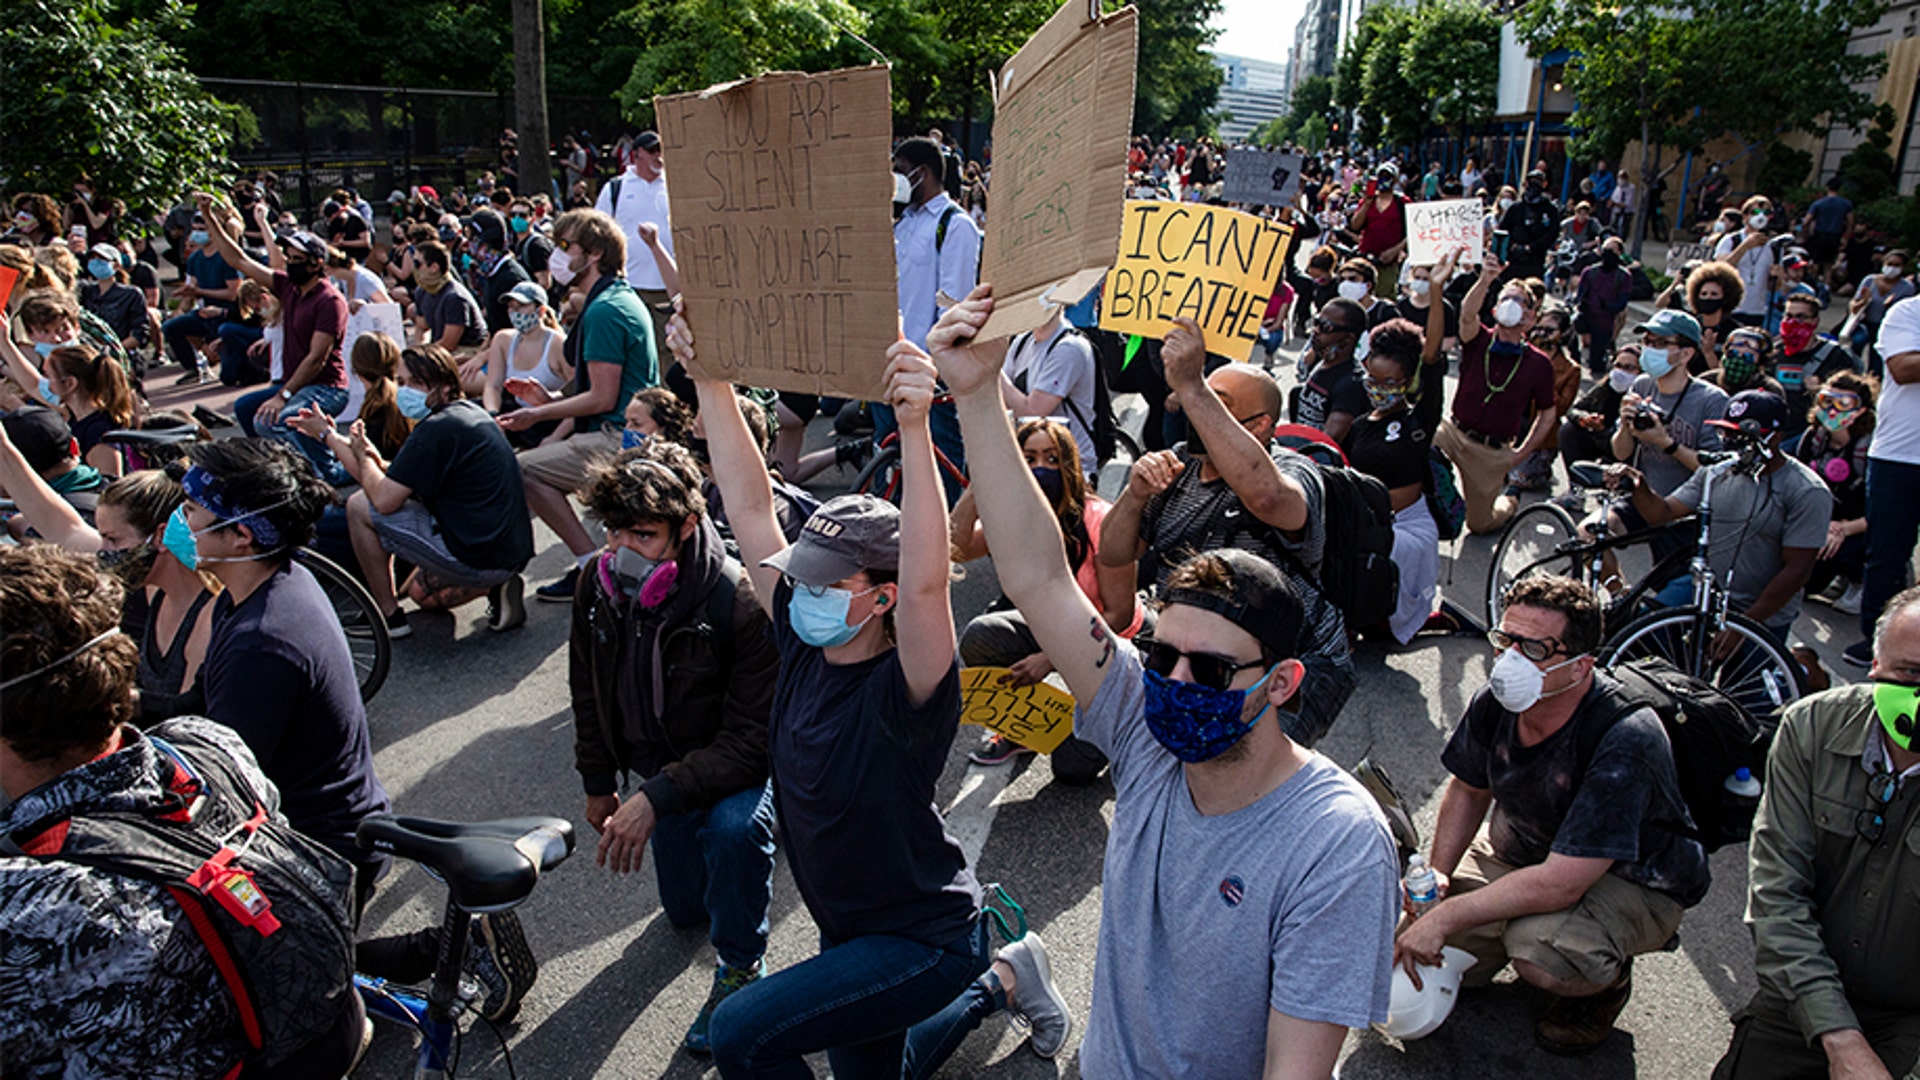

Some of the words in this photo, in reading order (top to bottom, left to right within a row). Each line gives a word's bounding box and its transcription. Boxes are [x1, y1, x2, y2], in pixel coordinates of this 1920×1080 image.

[659, 99, 694, 149] IF
[715, 88, 771, 148] YOU
[788, 77, 851, 144] ARE
[704, 143, 821, 213] SILENT
[672, 224, 740, 289] THEN
[750, 224, 793, 287] YOU
[800, 225, 853, 284] ARE
[716, 292, 853, 376] COMPLICIT
[1110, 269, 1269, 341] BREATHE
